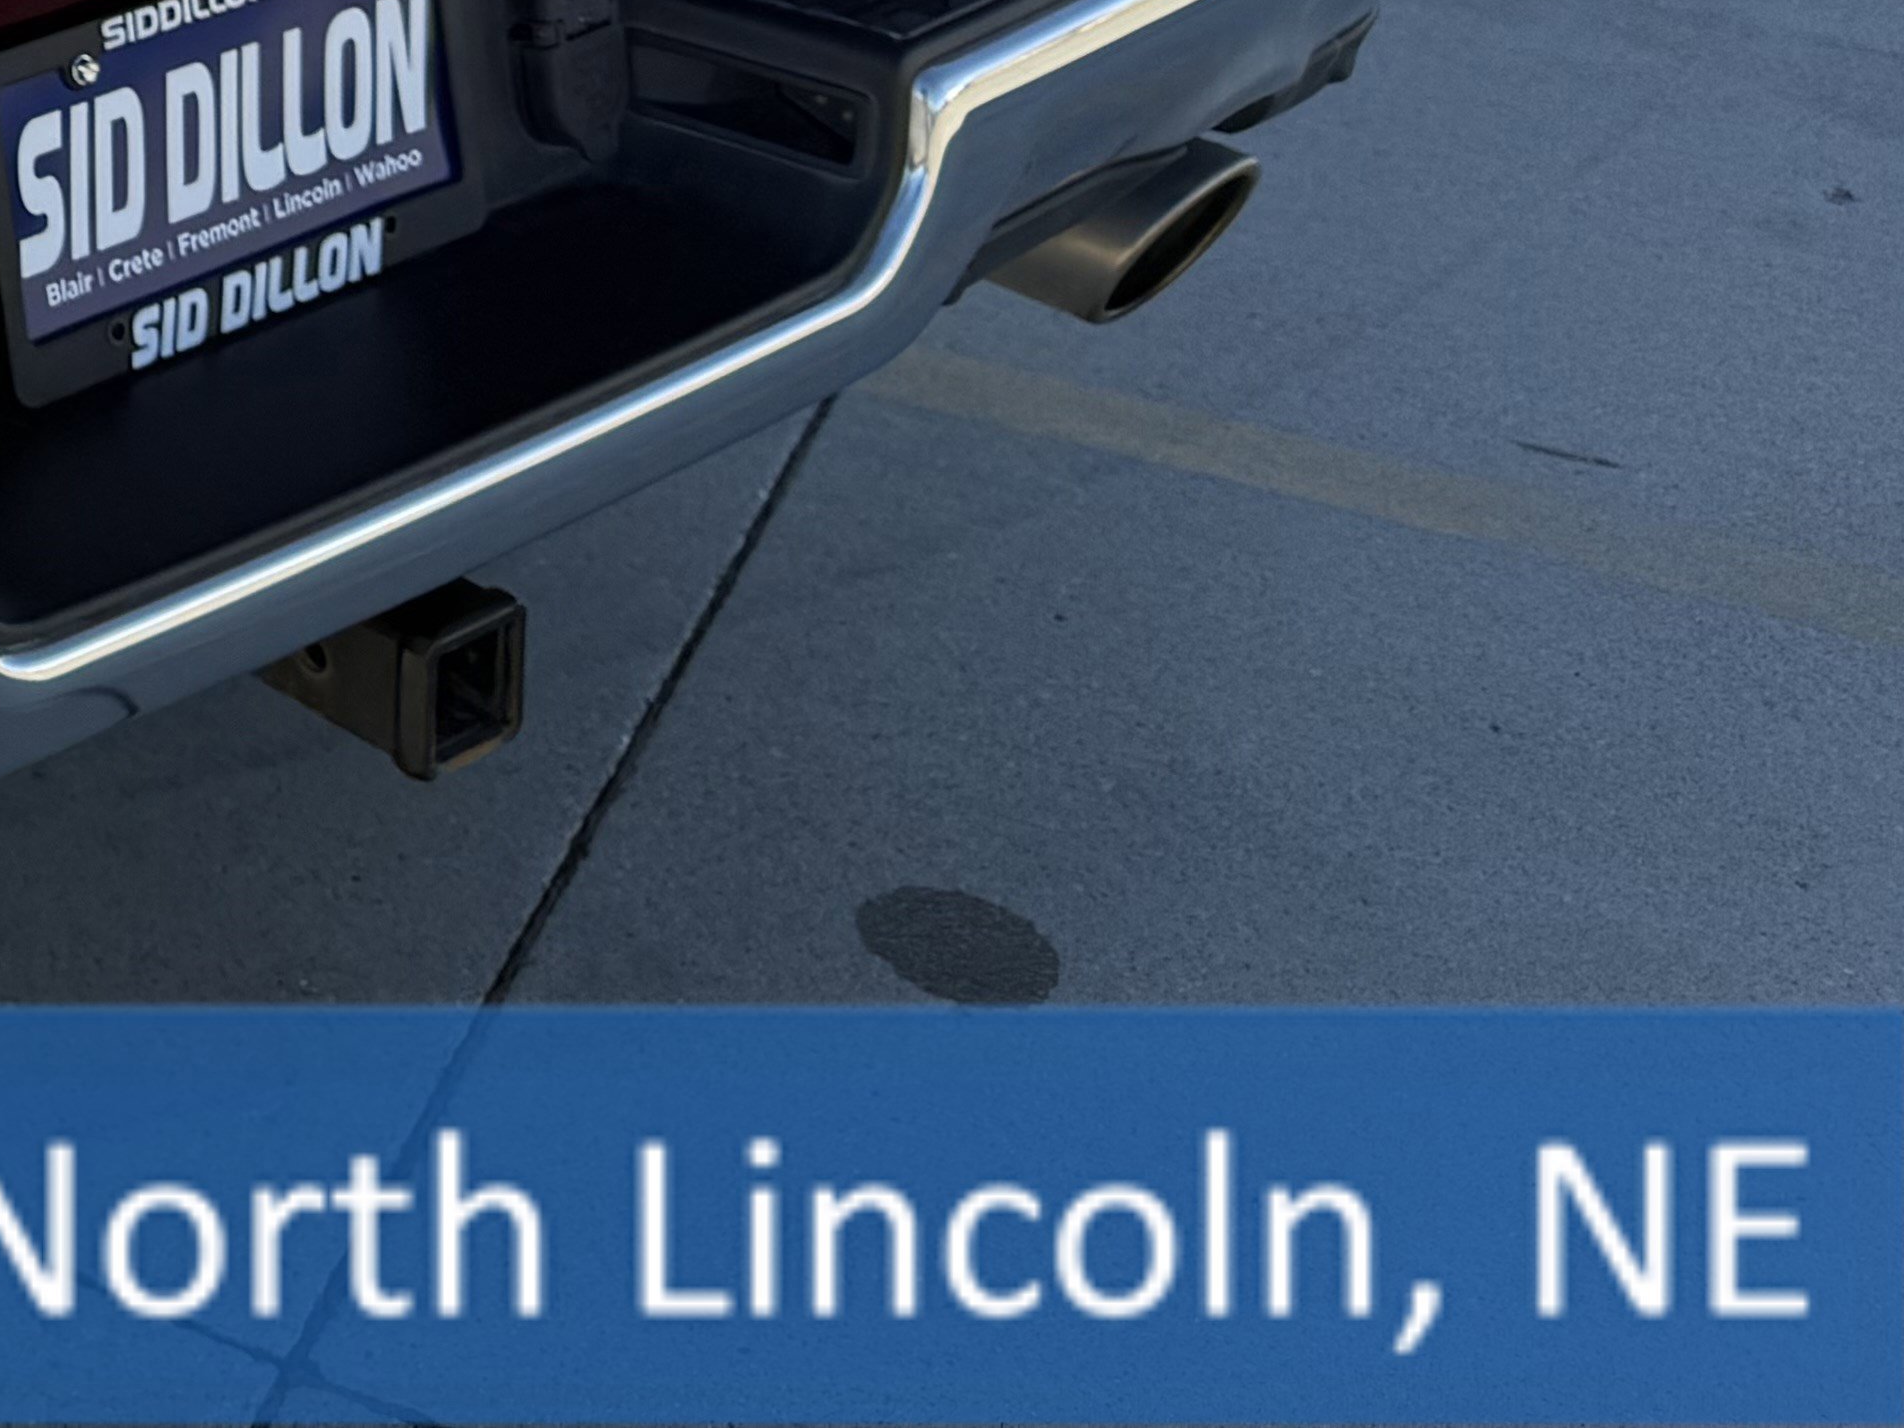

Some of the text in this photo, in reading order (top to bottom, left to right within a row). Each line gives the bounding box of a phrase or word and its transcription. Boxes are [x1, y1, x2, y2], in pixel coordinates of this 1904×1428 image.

[17, 86, 146, 279] SID
[46, 149, 423, 307] Blair Crete Fremont Lincoln Wahoo
[131, 217, 385, 370] SID DILLON
